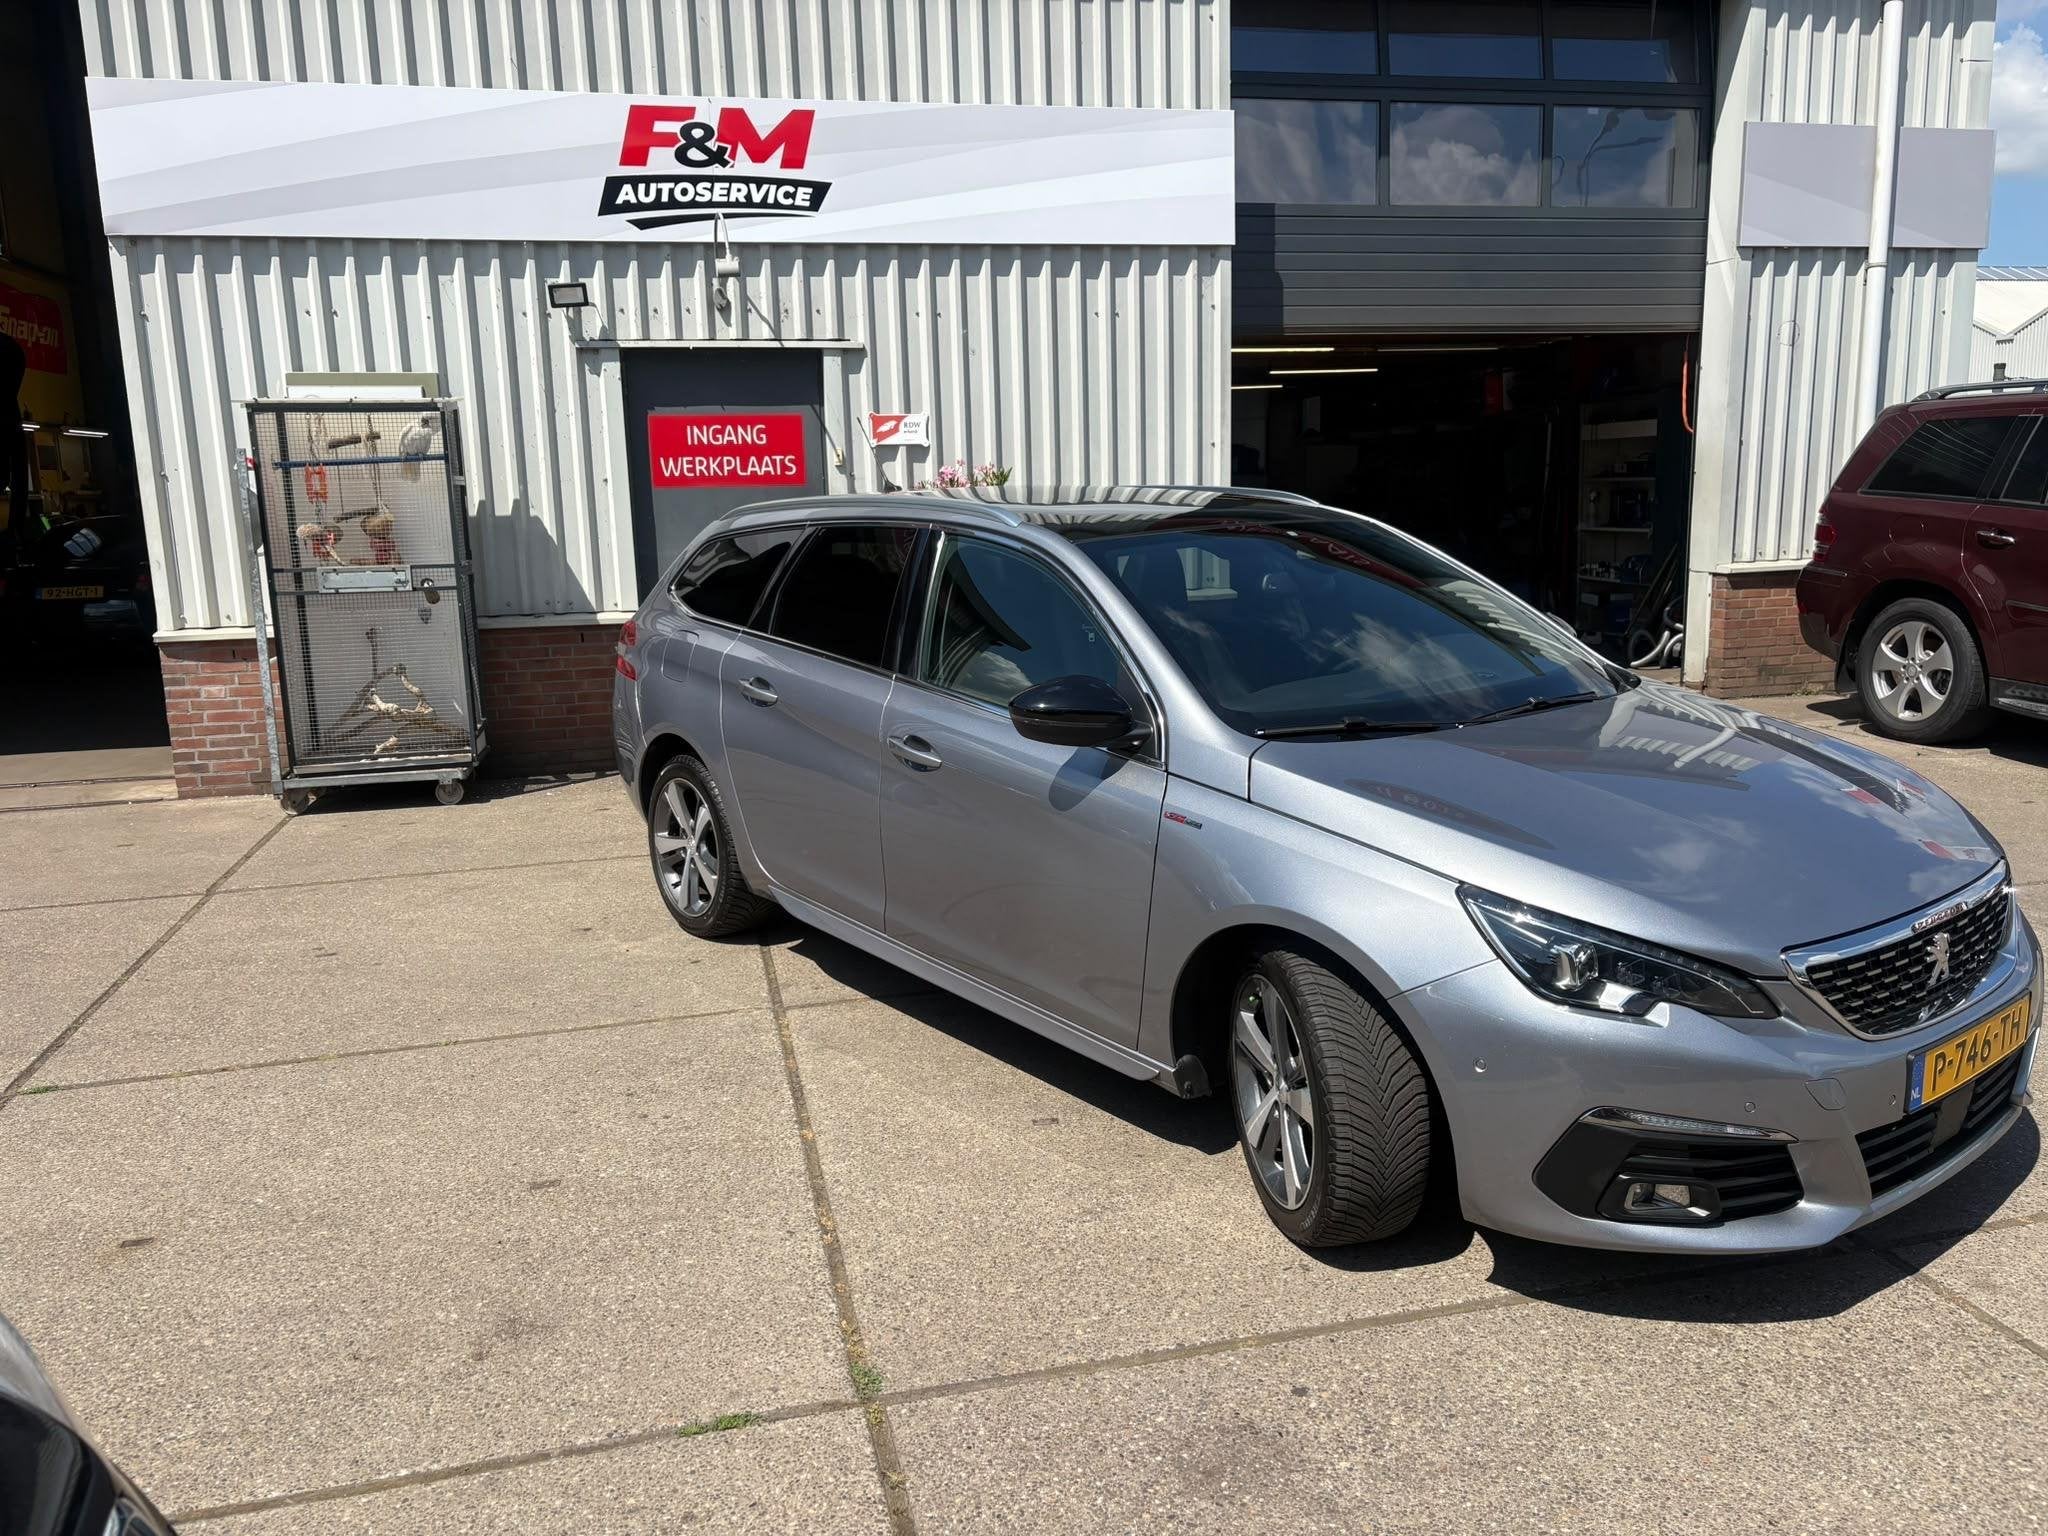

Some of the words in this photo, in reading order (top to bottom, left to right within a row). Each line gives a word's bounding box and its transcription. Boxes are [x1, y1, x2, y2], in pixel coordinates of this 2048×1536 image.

[618, 104, 816, 170] F&M
[615, 182, 813, 207] AUTOSERVICE
[686, 424, 767, 445] INGANG
[660, 455, 797, 477] WERKPLAATS
[1931, 1004, 2023, 1092] P-746-TH
[1910, 1088, 1921, 1101] NL
